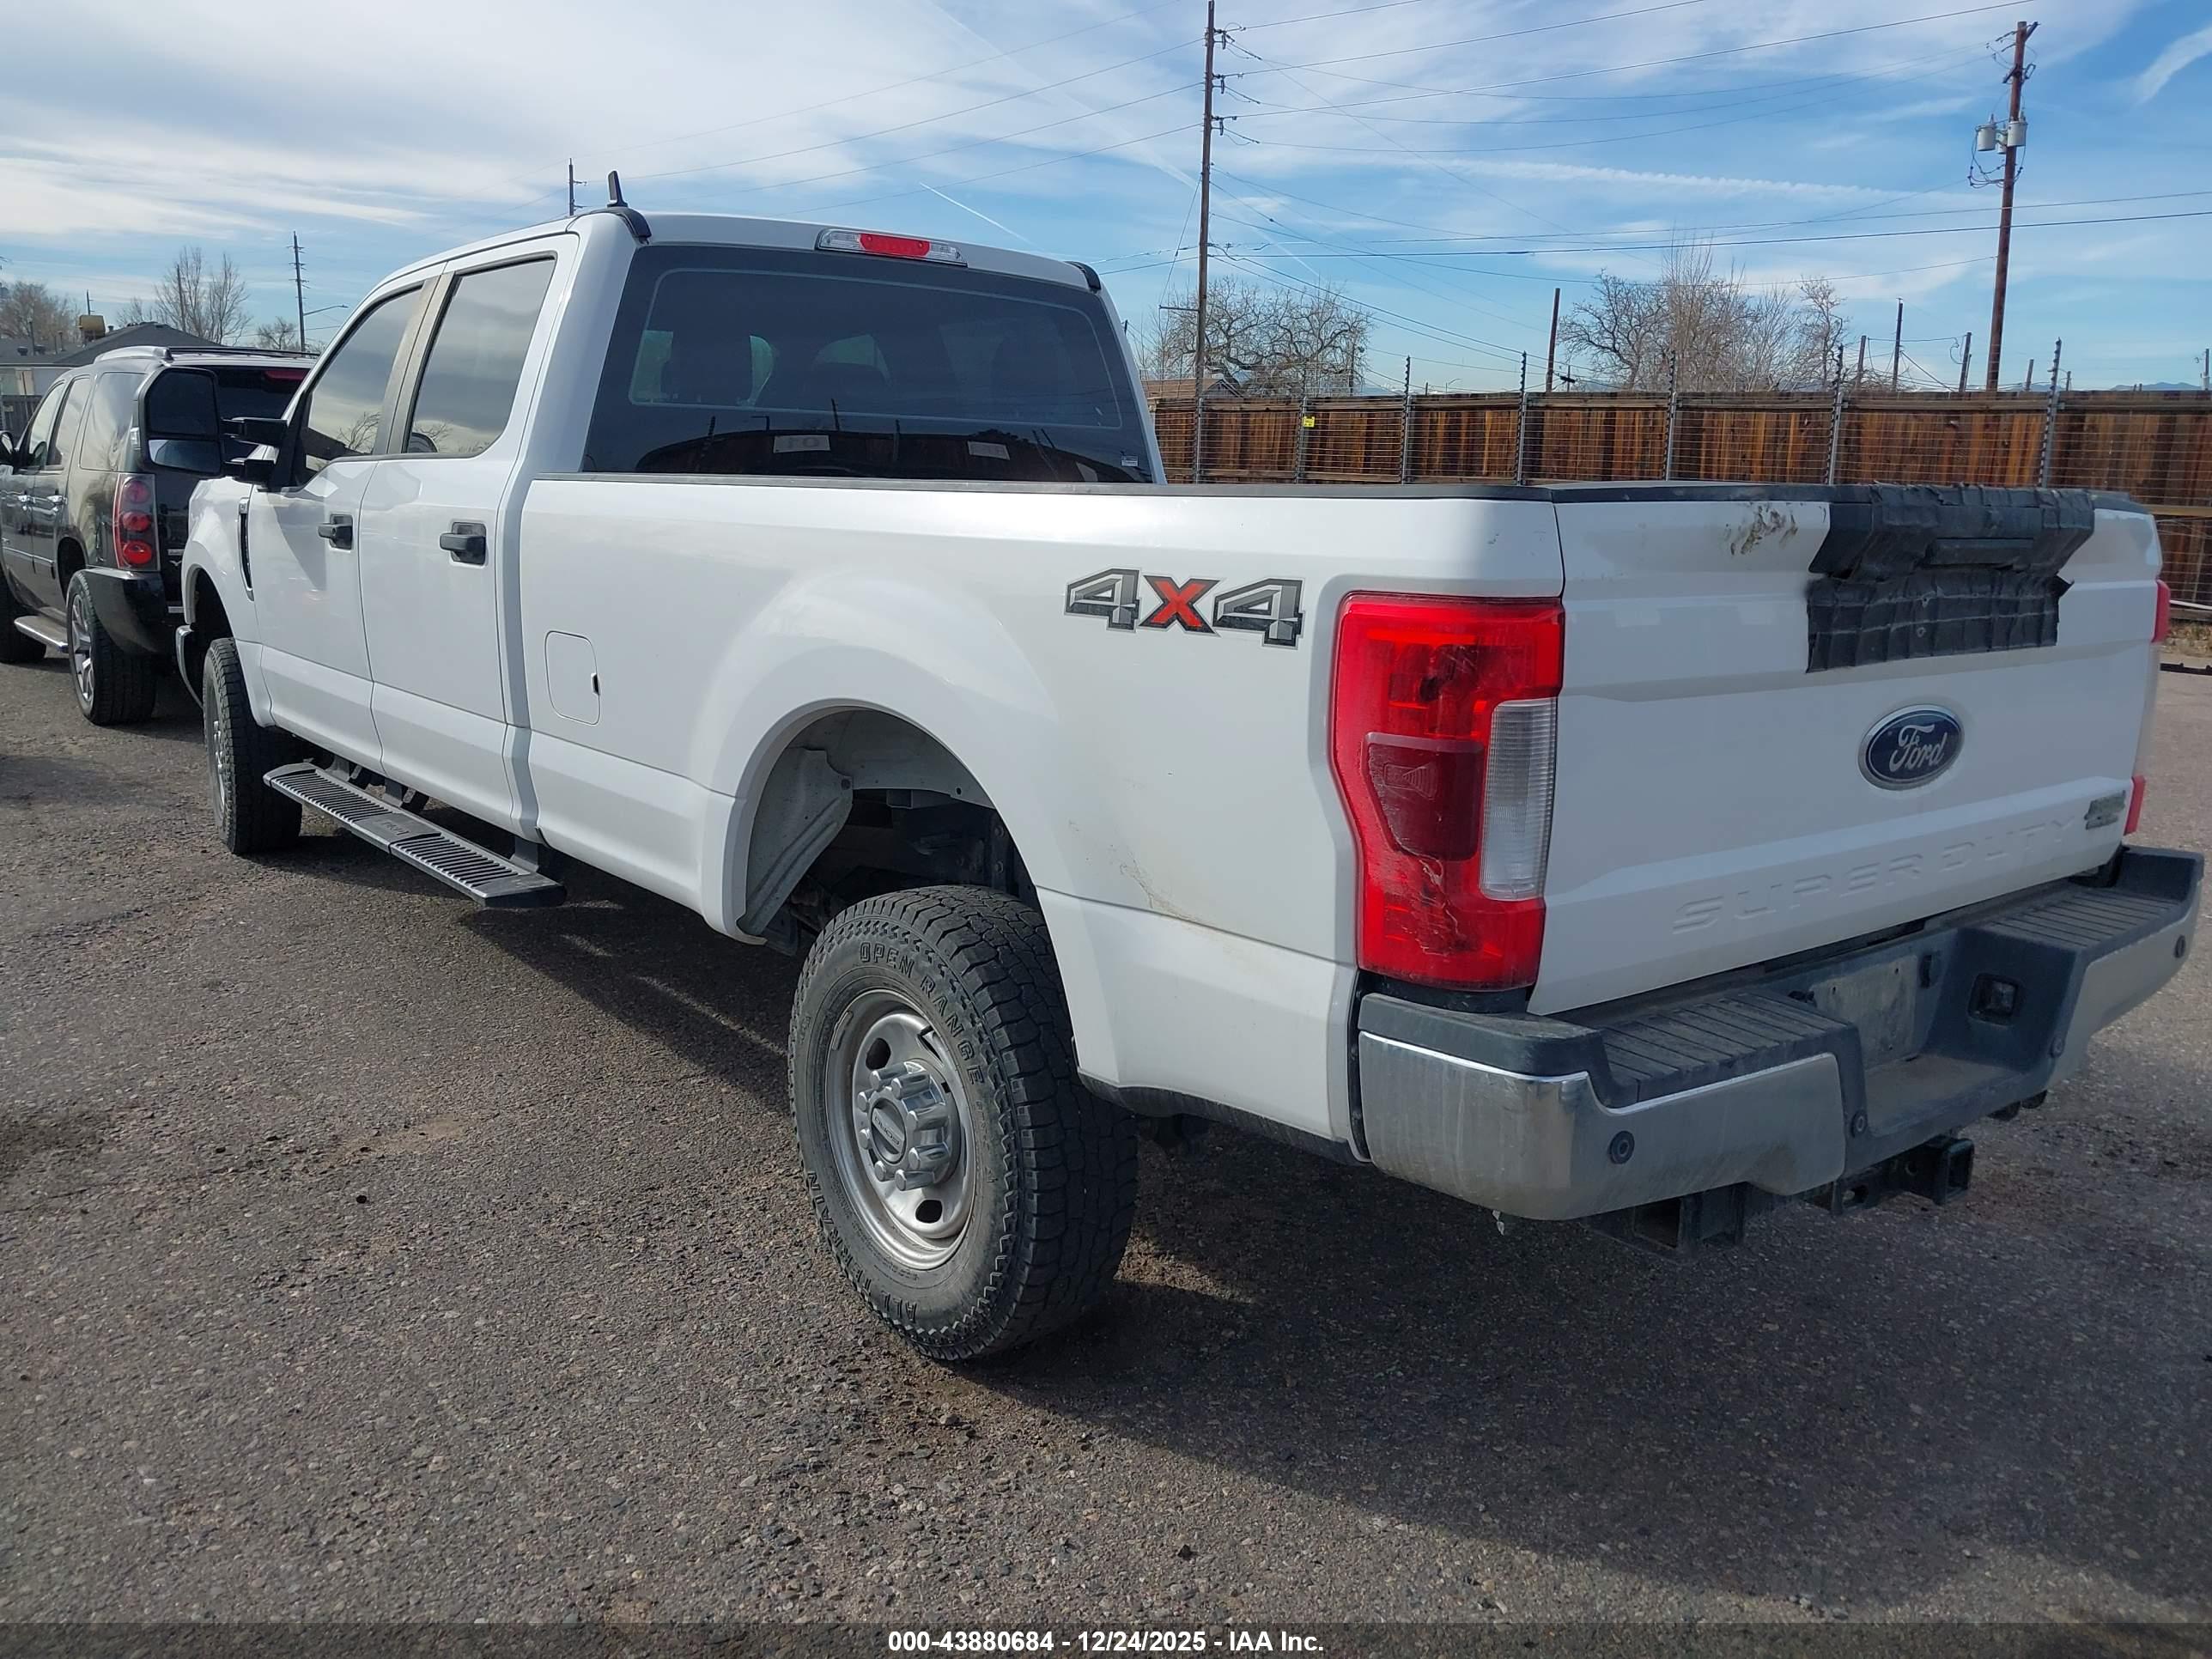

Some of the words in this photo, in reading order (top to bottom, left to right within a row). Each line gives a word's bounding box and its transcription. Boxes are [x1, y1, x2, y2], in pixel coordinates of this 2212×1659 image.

[1889, 725, 1948, 772] Ford
[1672, 854, 1923, 935] SUPER
[1938, 817, 2075, 873] DUTY
[860, 942, 915, 978] OPEN
[911, 975, 985, 1085] RANGE
[881, 1290, 917, 1323] ALL
